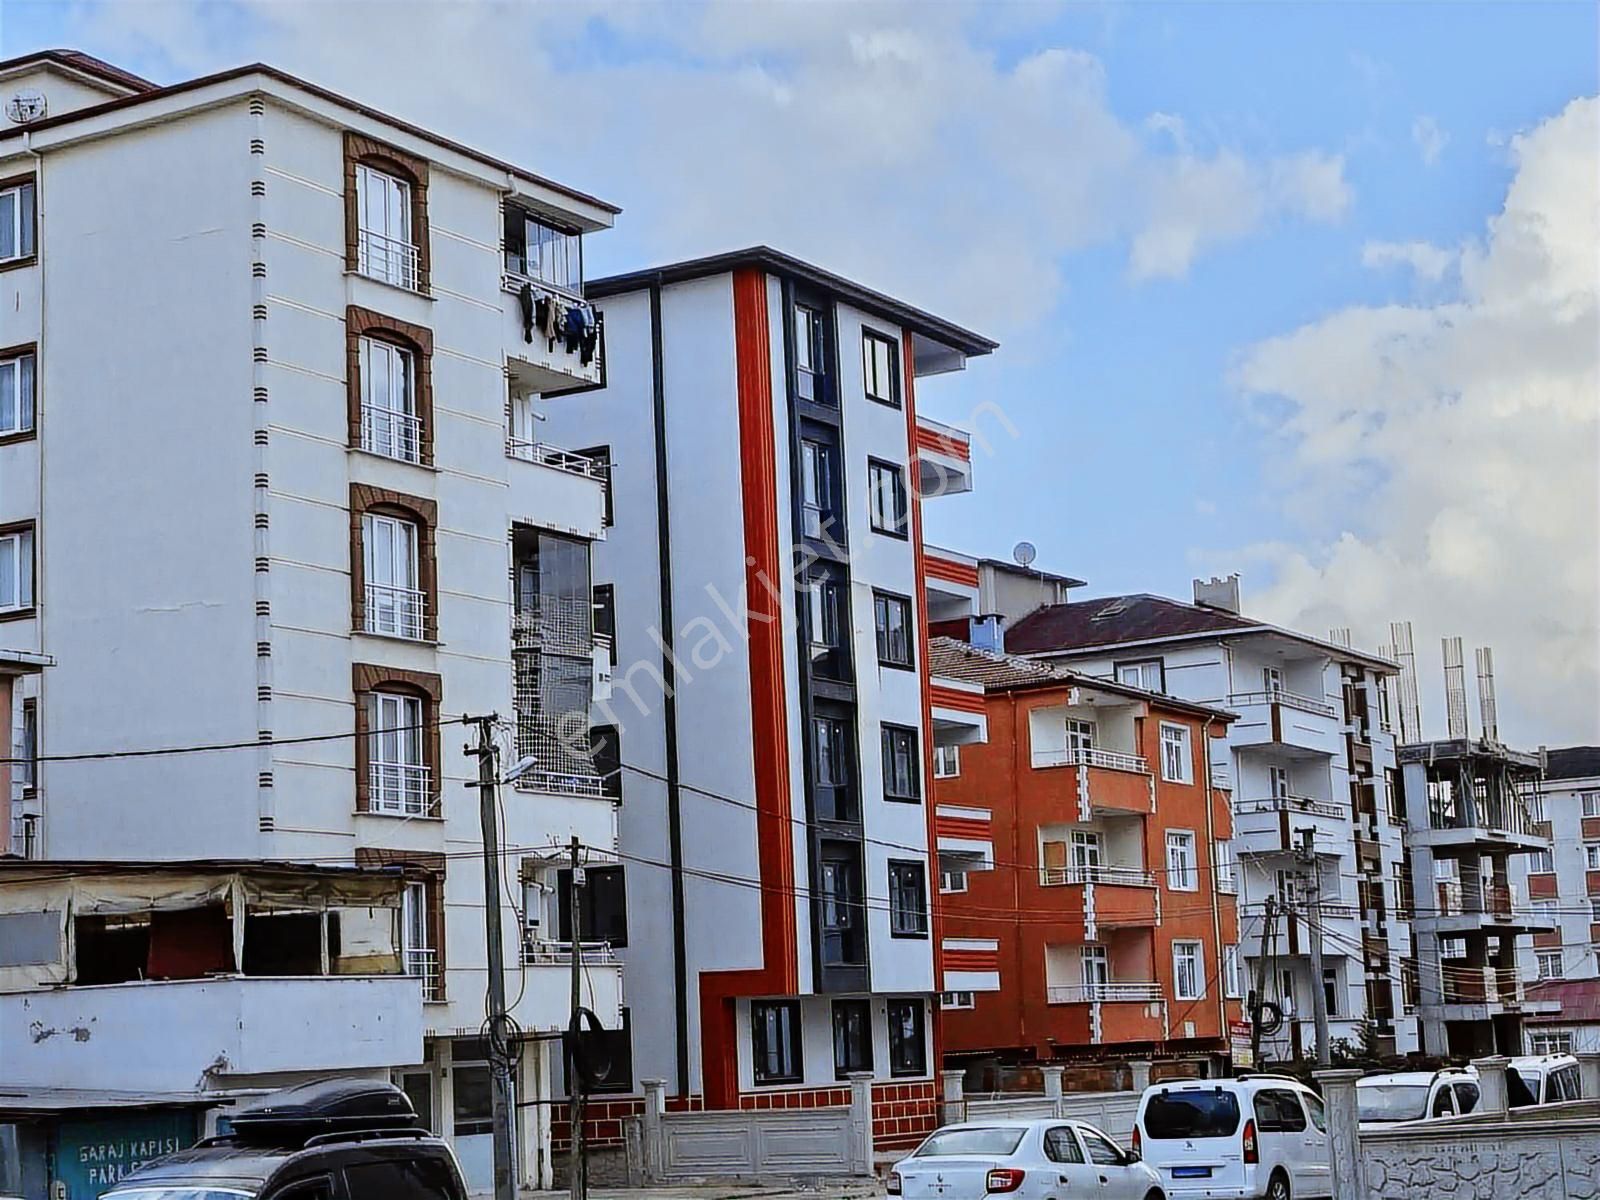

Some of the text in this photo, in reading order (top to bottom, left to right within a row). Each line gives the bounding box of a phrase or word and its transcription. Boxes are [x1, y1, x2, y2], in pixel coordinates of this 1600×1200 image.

[79, 1136, 179, 1162] GARAJ KAPISI
[89, 1164, 125, 1185] PARK
